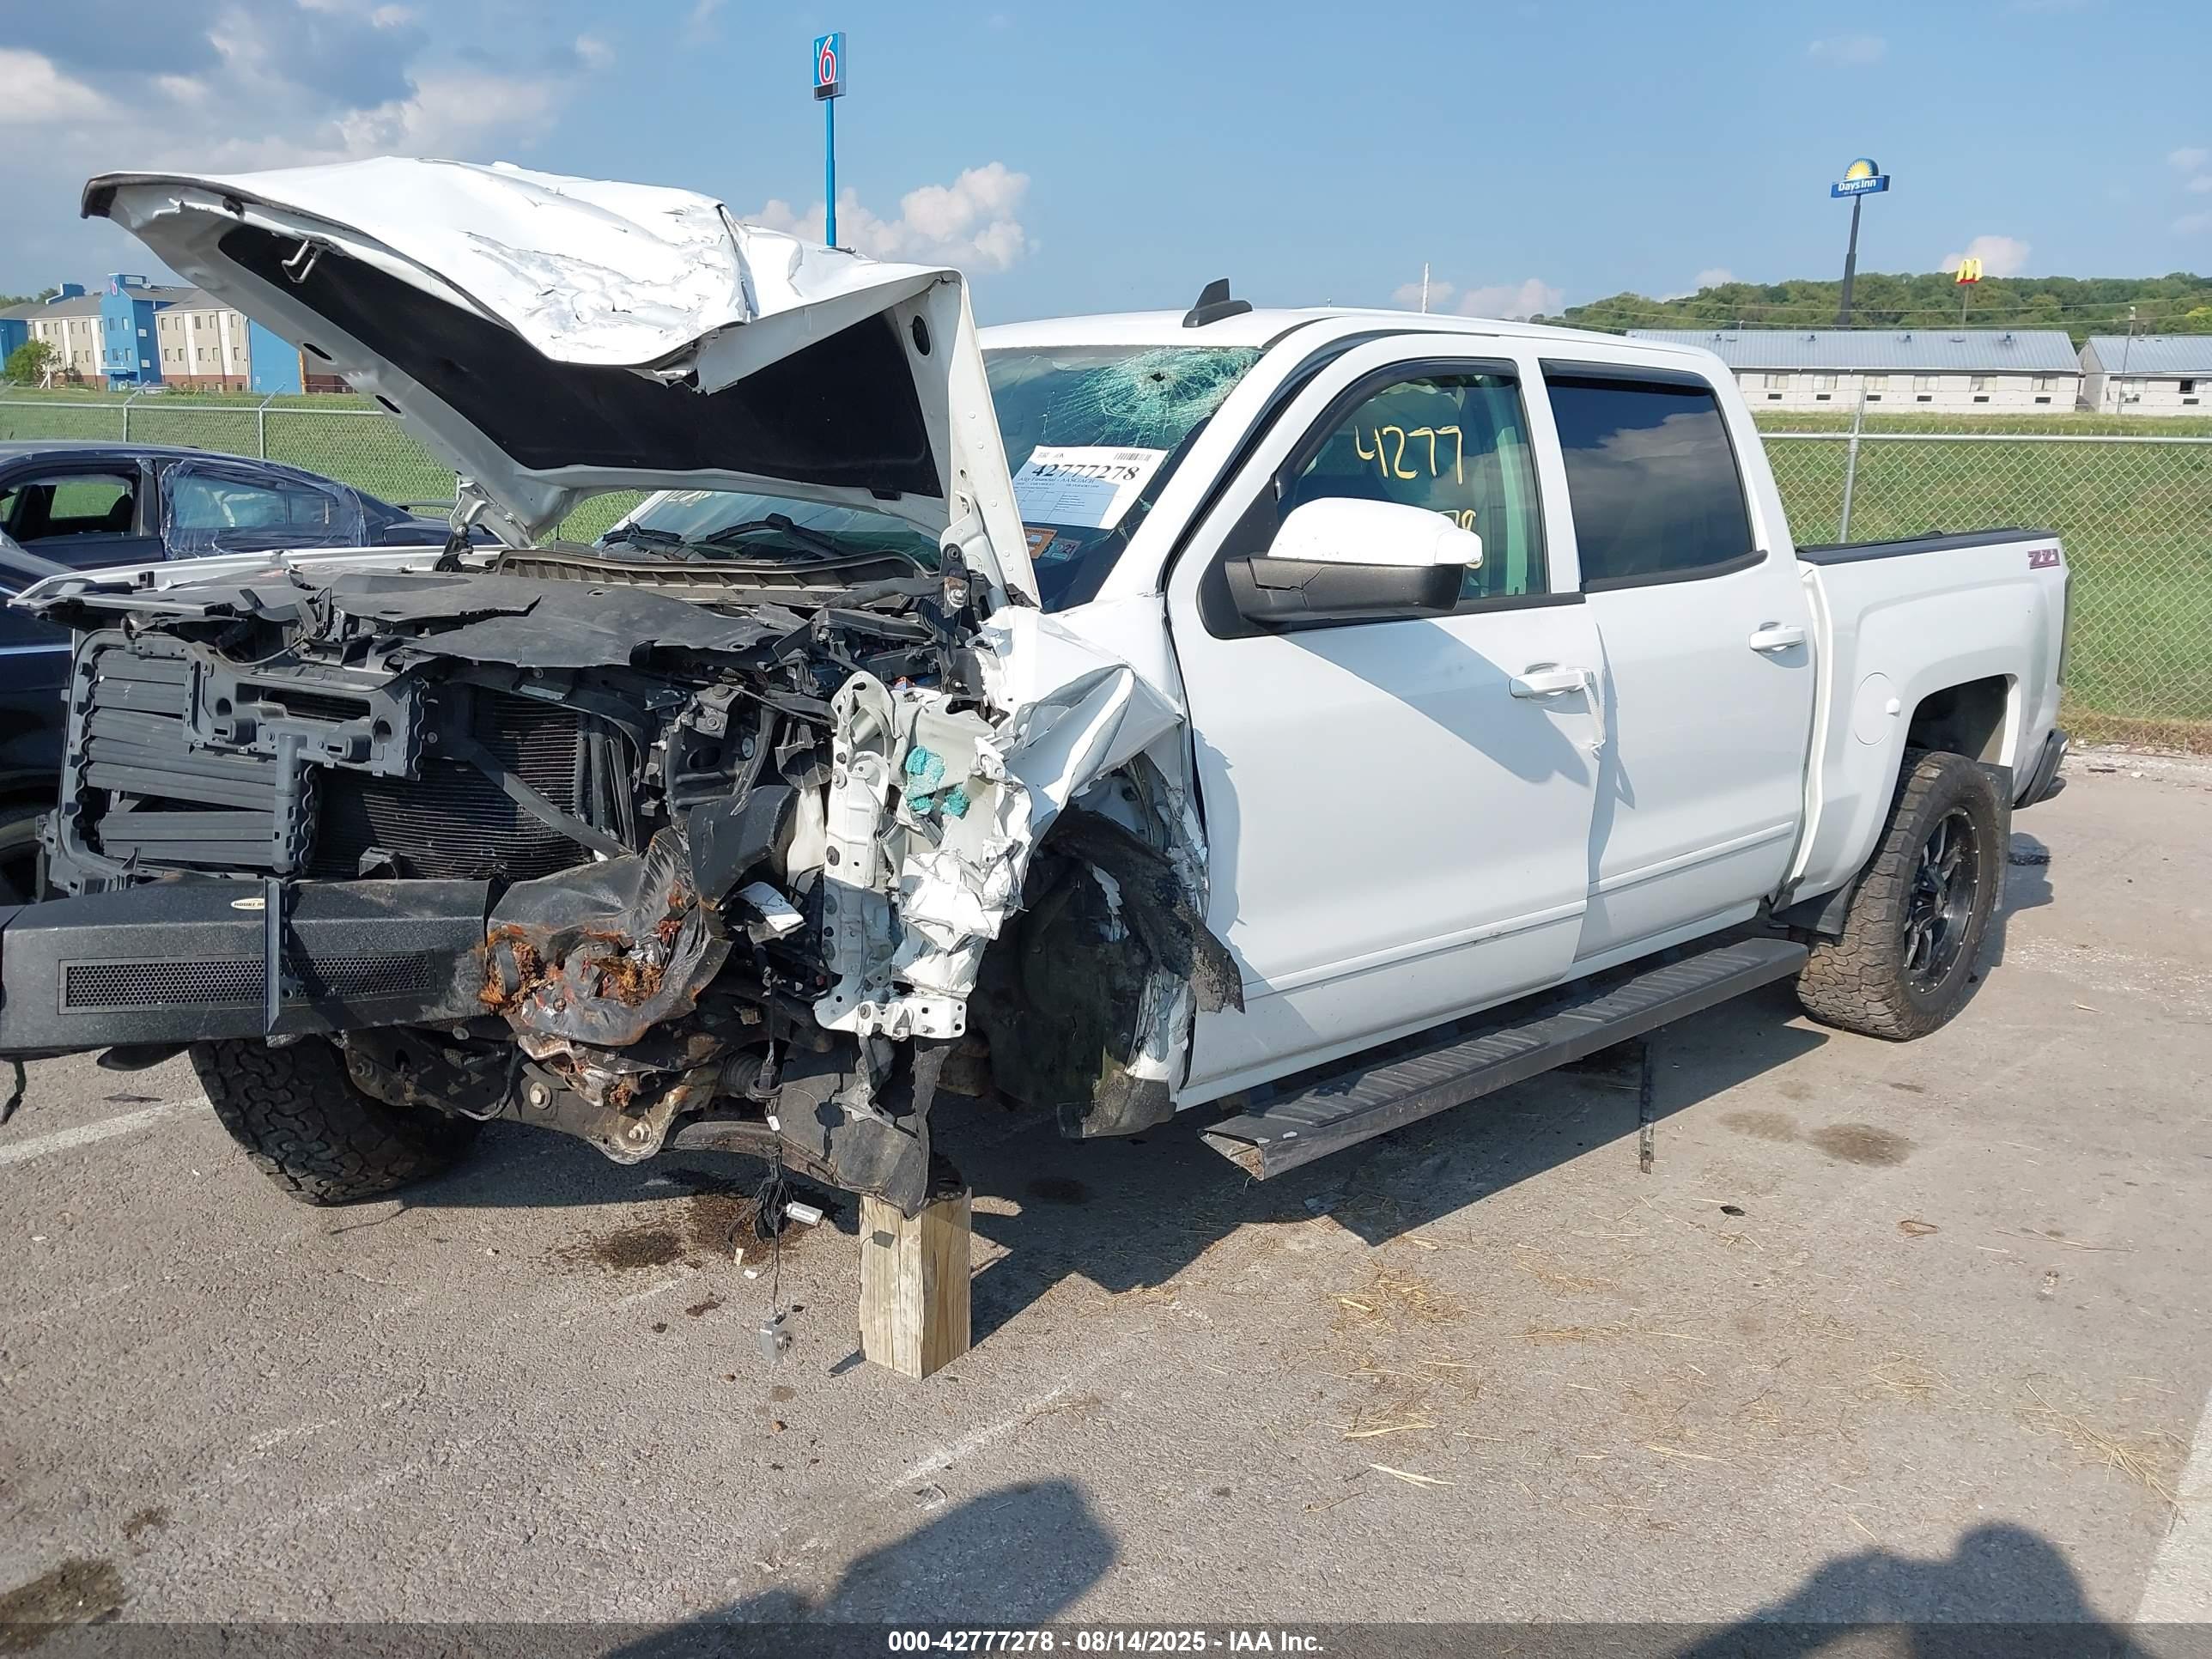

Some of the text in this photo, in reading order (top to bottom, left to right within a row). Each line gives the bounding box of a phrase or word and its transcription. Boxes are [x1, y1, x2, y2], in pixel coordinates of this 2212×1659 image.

[818, 34, 837, 85] 6
[1838, 179, 1877, 191] Days Inn
[1354, 424, 1463, 485] 4277
[1031, 464, 1140, 481] 42777278
